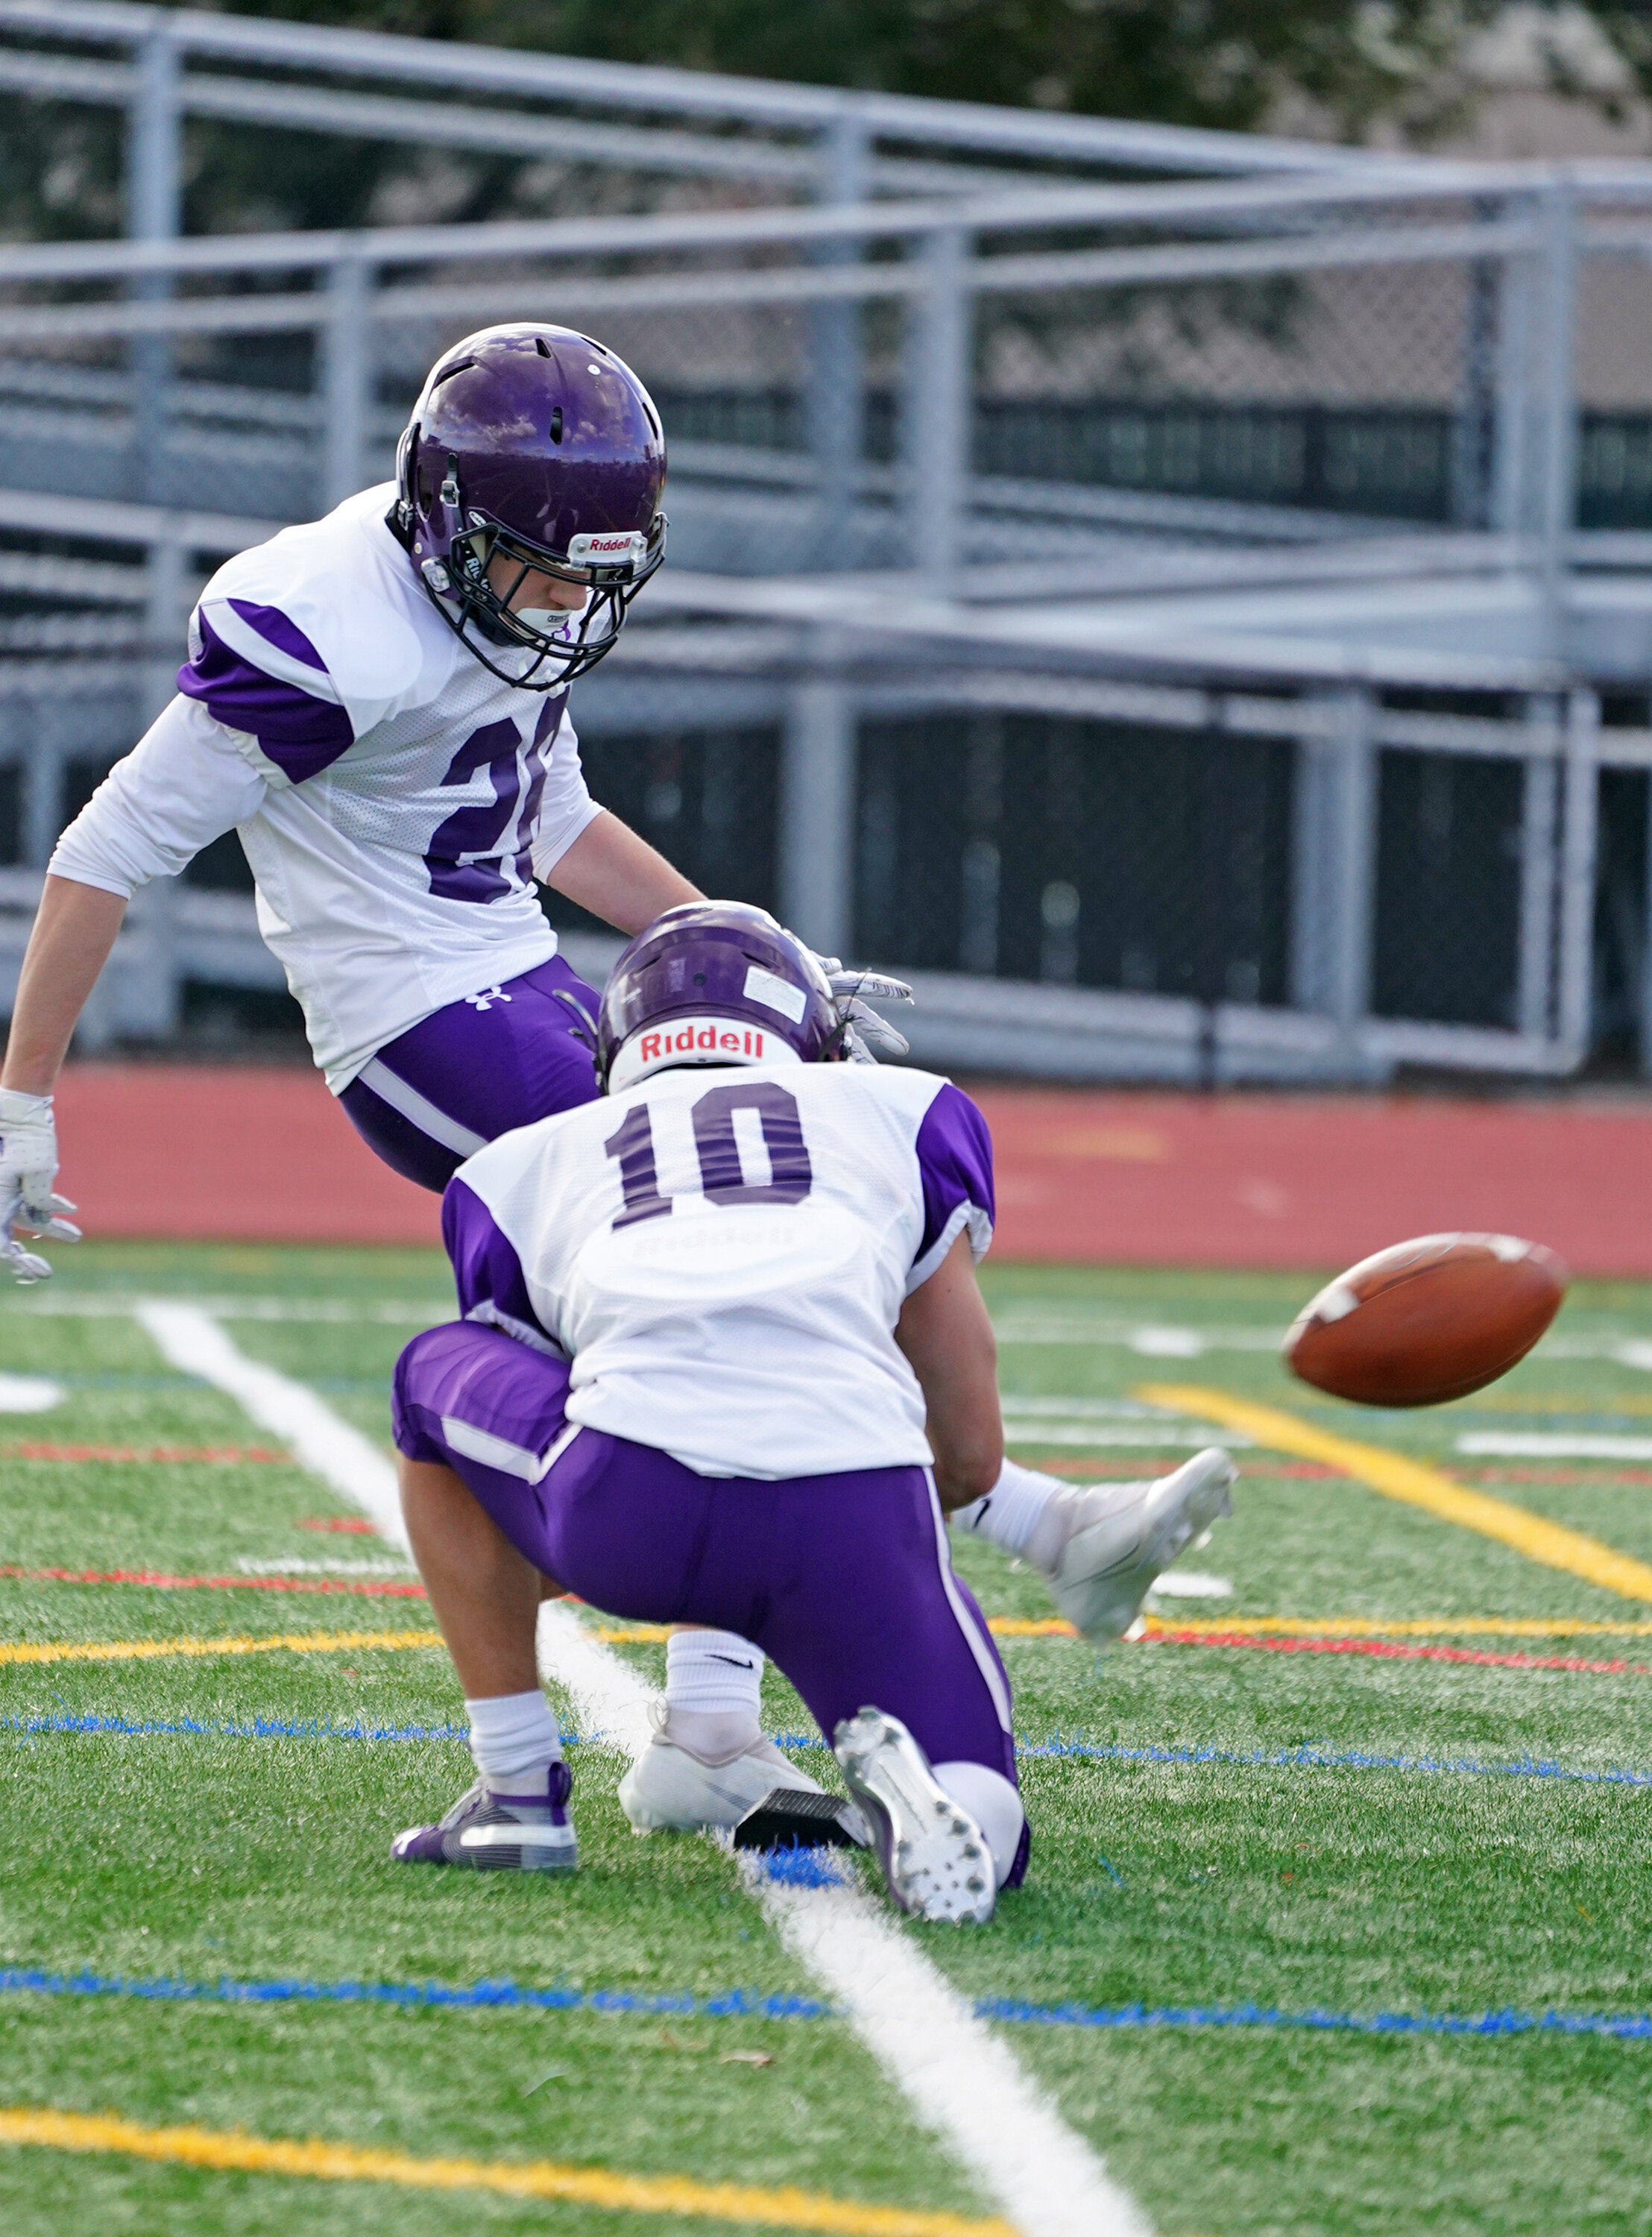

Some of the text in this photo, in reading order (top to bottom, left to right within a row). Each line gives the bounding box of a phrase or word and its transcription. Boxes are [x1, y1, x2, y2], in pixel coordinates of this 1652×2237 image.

[589, 536, 632, 551] Riddell
[640, 1025, 764, 1063] Riddell
[603, 1081, 813, 1235] 10
